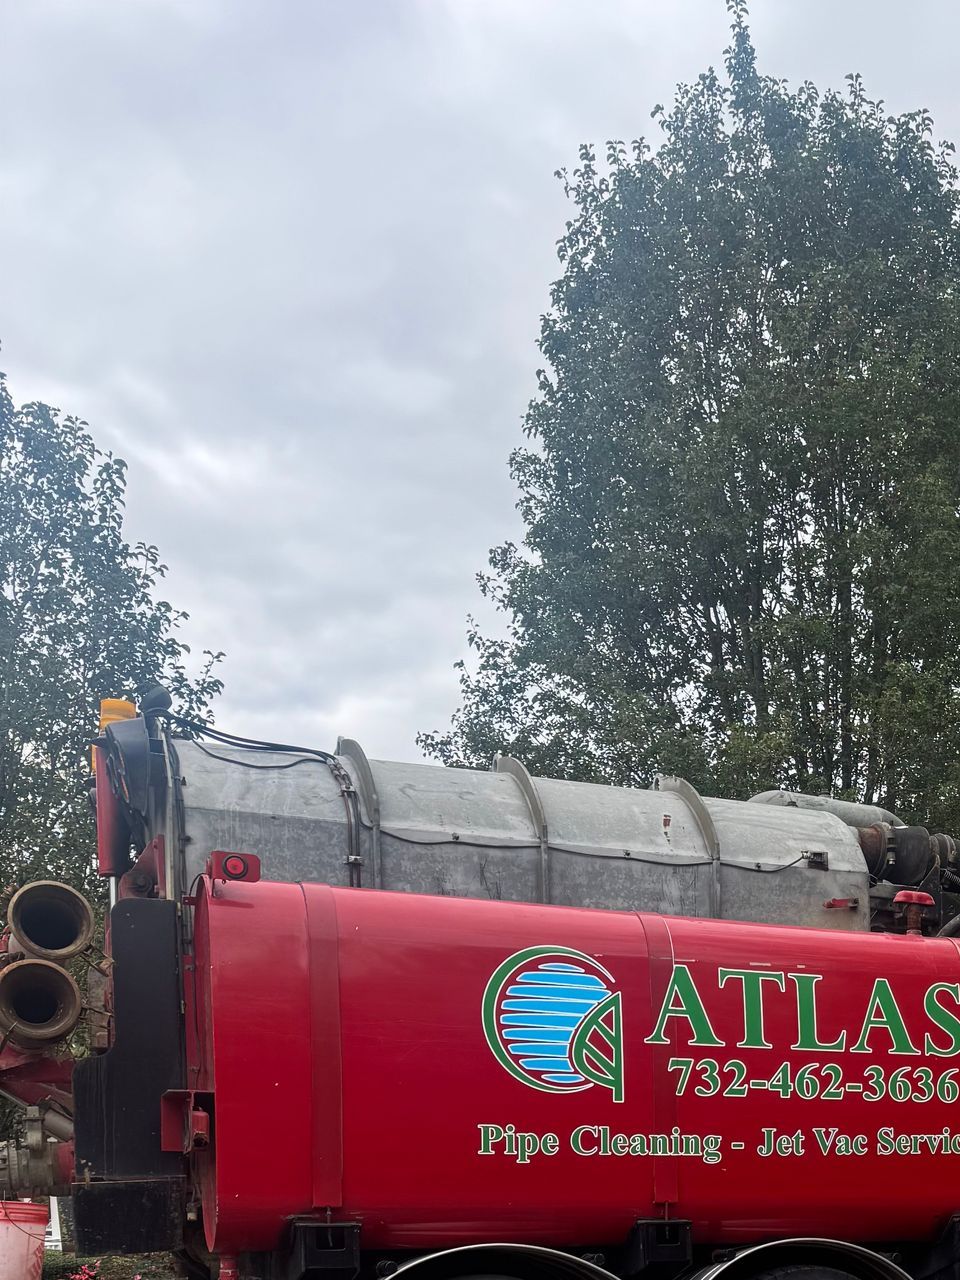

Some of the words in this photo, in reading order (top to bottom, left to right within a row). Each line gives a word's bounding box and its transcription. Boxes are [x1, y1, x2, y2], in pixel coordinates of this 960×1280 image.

[668, 1058, 960, 1103] 732-462-3636
[477, 1124, 559, 1164] Pipe
[571, 1125, 722, 1164] Cleaning
[757, 1127, 806, 1157] Jet
[815, 1127, 868, 1157] Vac
